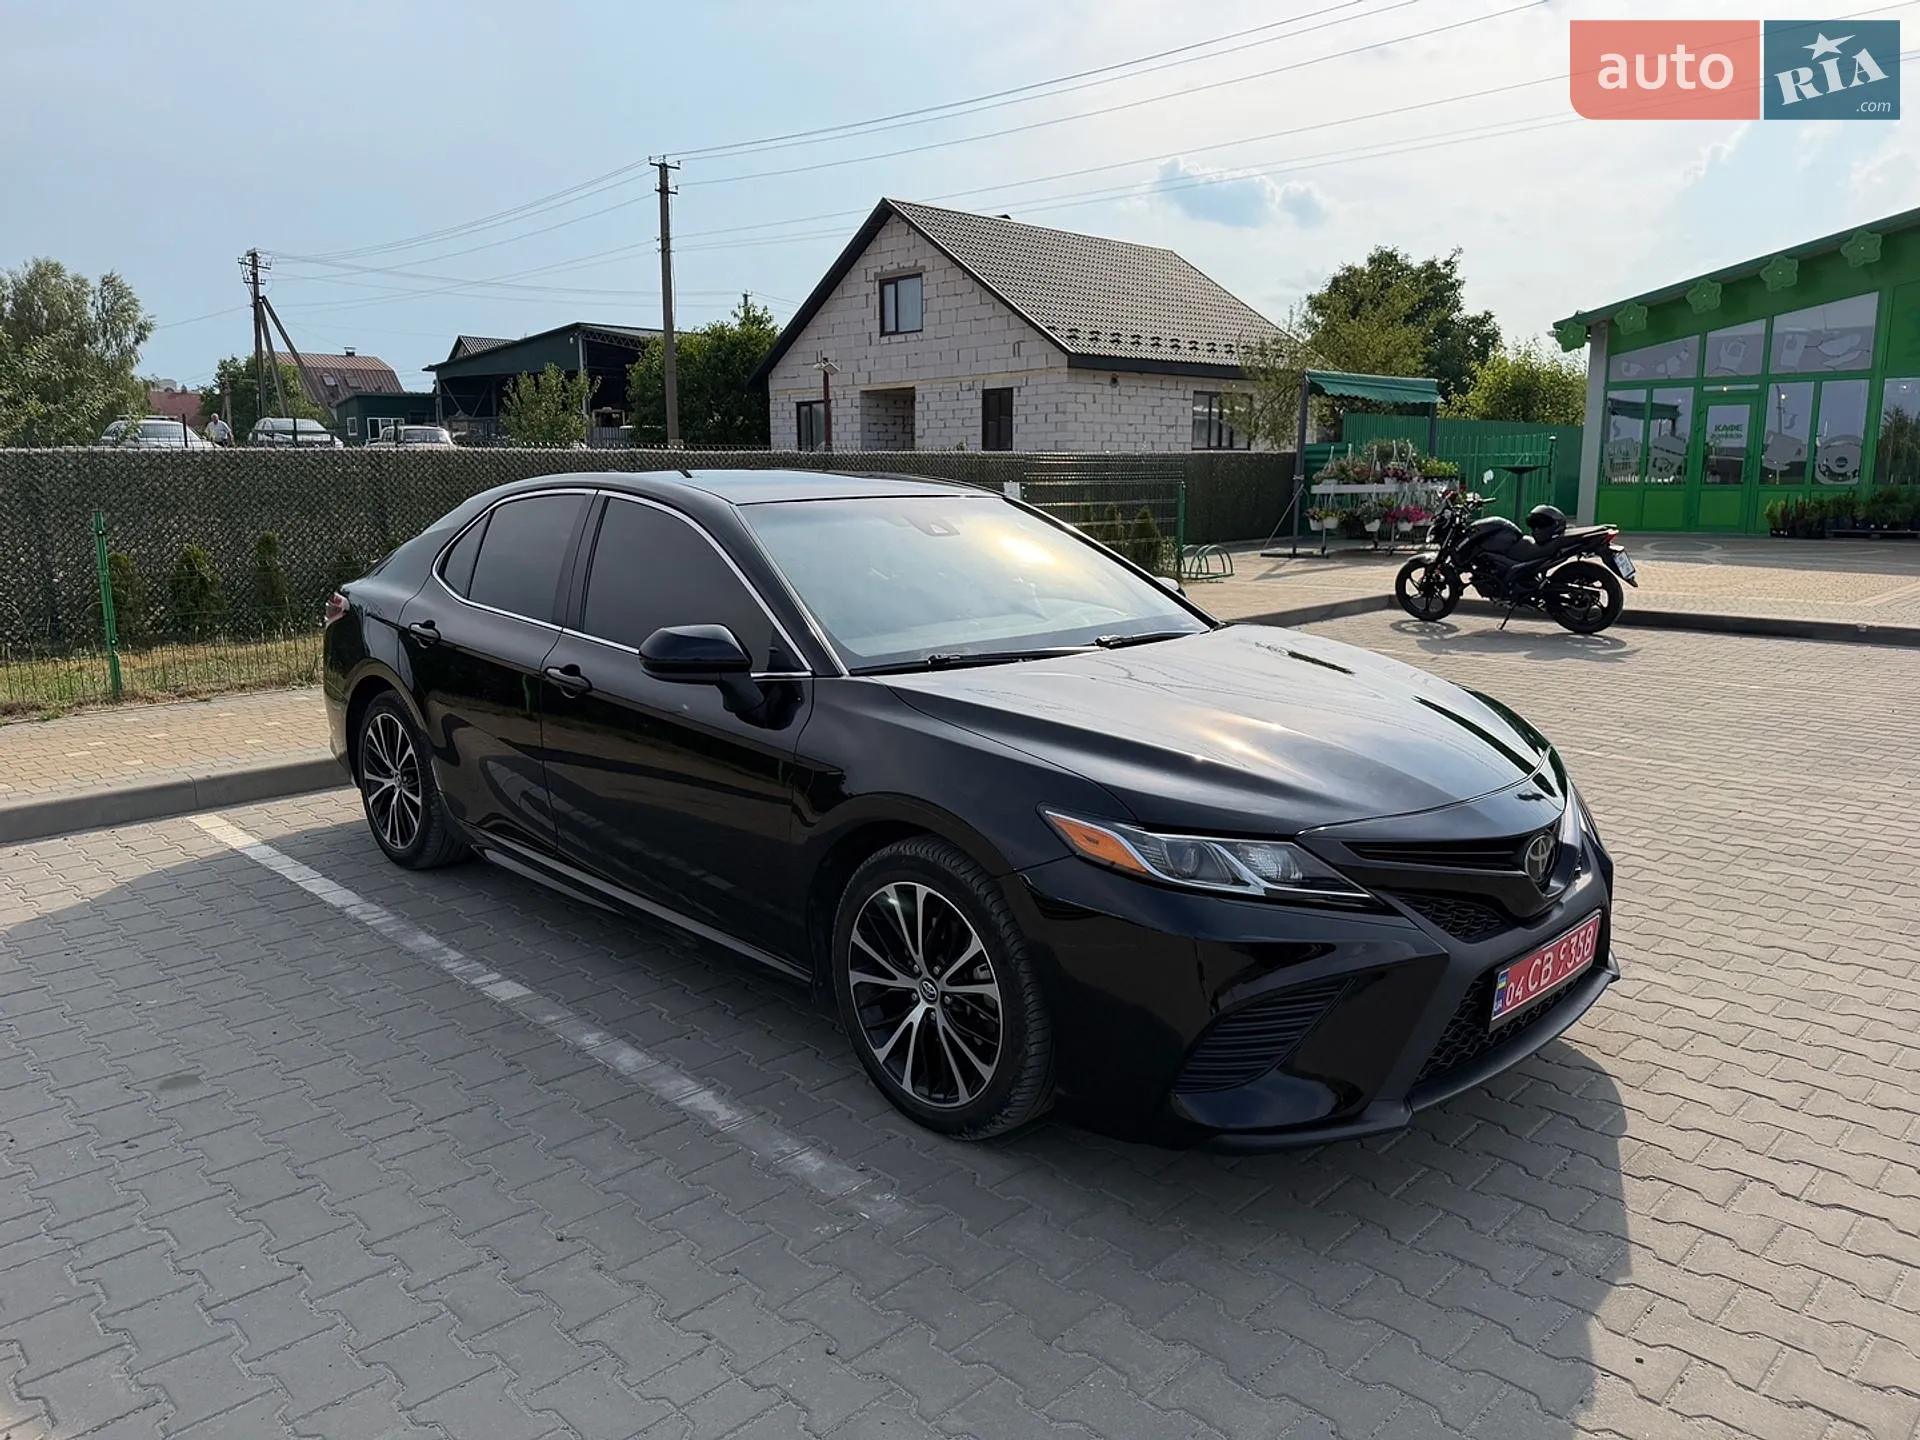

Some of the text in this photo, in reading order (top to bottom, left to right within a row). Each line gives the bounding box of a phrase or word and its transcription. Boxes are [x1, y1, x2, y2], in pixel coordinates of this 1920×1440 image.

[1714, 424, 1744, 432] КАФЕ
[1505, 975, 1524, 1007] 04
[1528, 951, 1554, 992] CB
